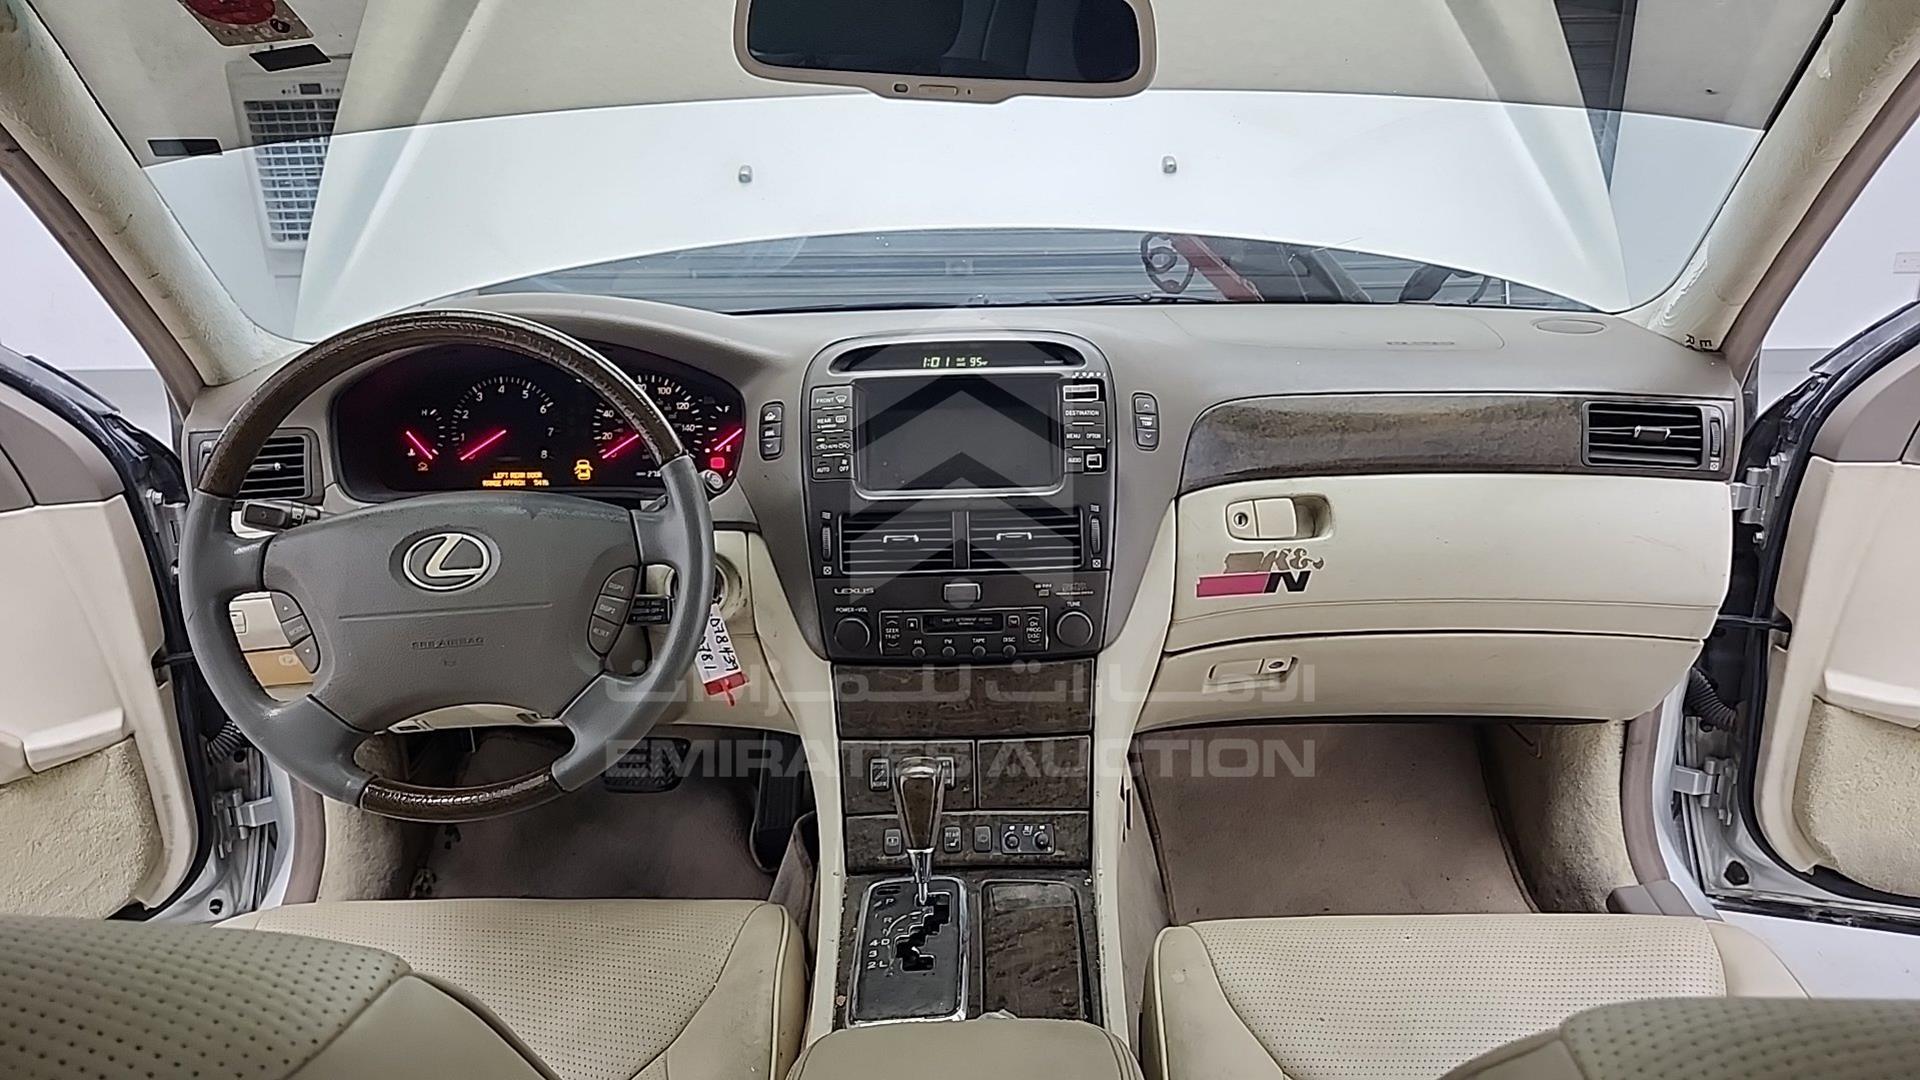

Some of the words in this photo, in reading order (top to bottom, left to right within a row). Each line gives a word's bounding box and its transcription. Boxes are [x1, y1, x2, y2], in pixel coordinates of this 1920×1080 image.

[497, 385, 505, 394] 4
[522, 389, 530, 399] 5
[657, 386, 672, 395] 100
[475, 391, 484, 402] 3
[539, 404, 548, 415] 6
[676, 401, 690, 410] 120
[724, 405, 731, 413] F
[462, 409, 470, 419] 2
[602, 409, 615, 418] 40
[547, 426, 555, 437] 7
[681, 423, 696, 432] 140
[601, 432, 613, 441] 20
[540, 449, 548, 460] 8
[833, 586, 875, 595] LEXUS
[868, 949, 878, 958] 3
